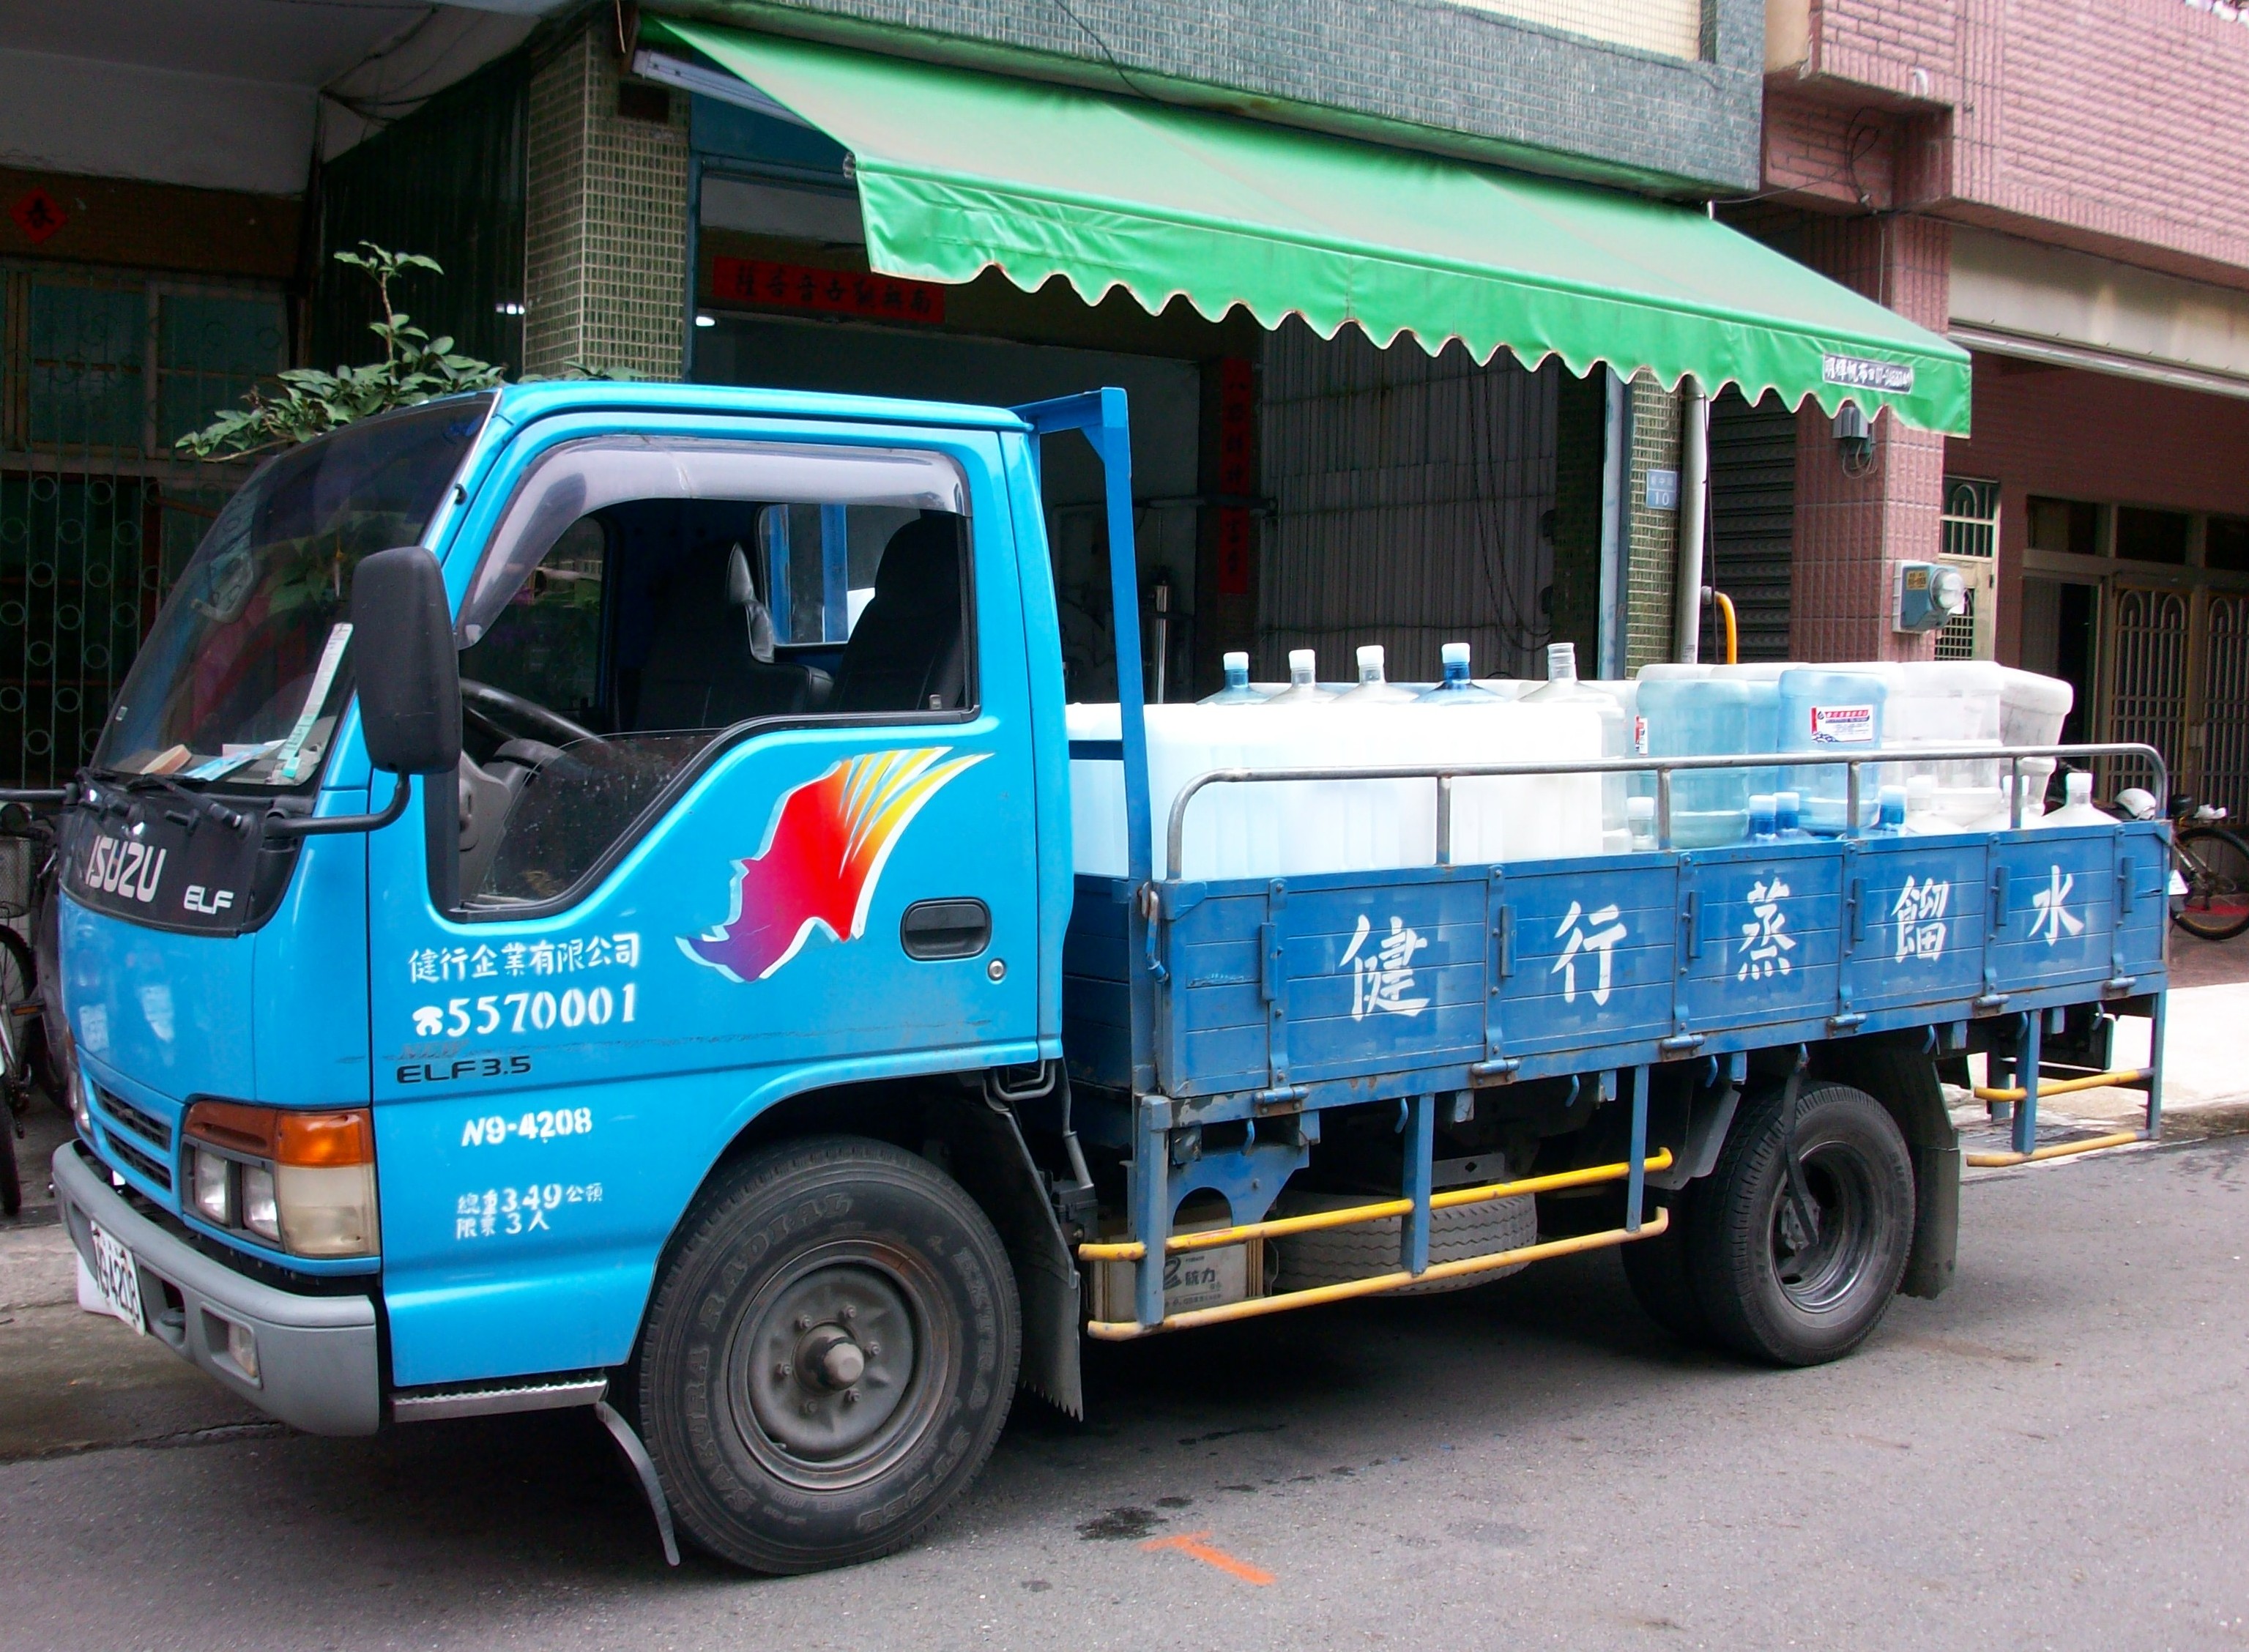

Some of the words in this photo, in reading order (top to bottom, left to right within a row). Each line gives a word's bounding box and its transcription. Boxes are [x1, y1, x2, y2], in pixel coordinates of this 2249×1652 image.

[1655, 491, 1670, 506] 10
[85, 834, 167, 902] ISUZU
[183, 885, 234, 915] ELF
[409, 933, 639, 983] 健行企業有限公司
[447, 983, 635, 1037] 5570001
[396, 1060, 476, 1084] ELF
[482, 1055, 531, 1077] 3.5
[461, 1108, 592, 1146] N9-4208
[699, 1194, 853, 1333] RADIAL
[685, 1349, 757, 1512] SAKURA
